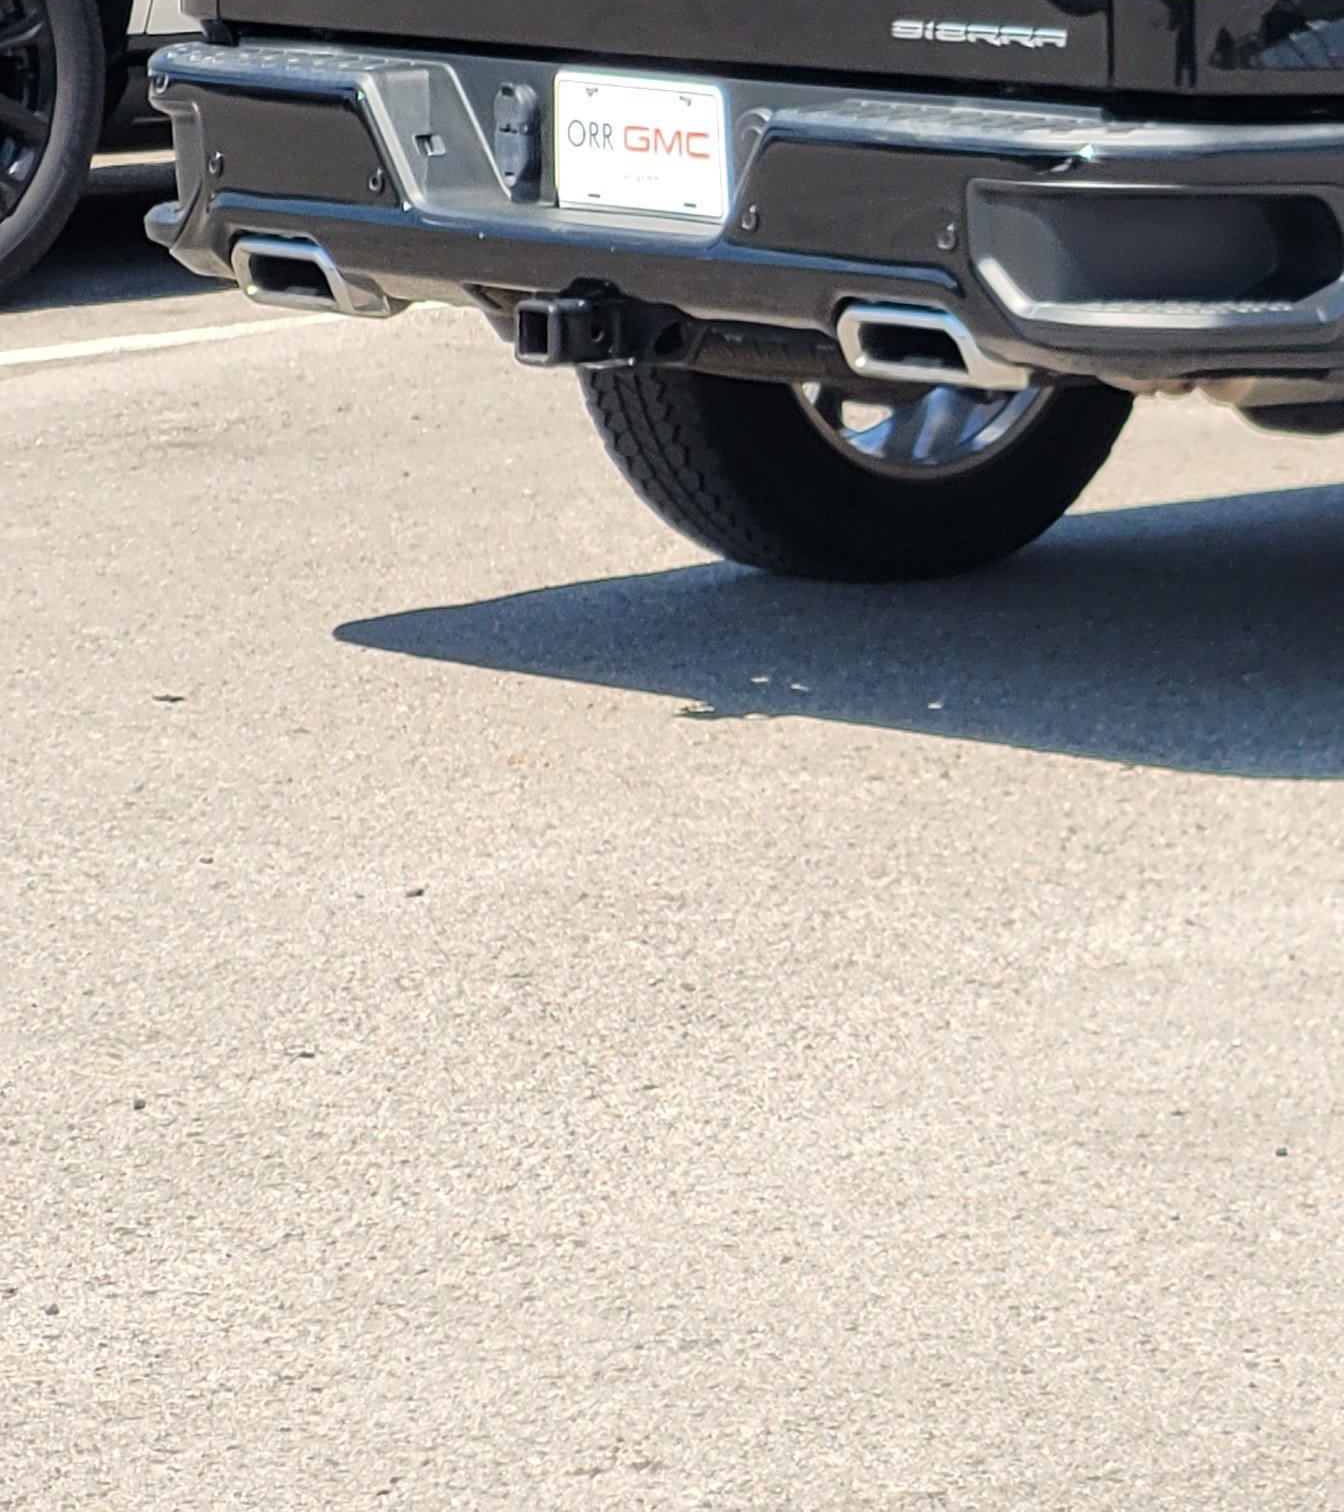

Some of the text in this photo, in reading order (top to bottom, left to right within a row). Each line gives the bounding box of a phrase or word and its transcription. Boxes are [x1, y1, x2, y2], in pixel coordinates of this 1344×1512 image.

[891, 19, 1068, 49] SIERRA
[567, 119, 711, 160] ORR GMC
